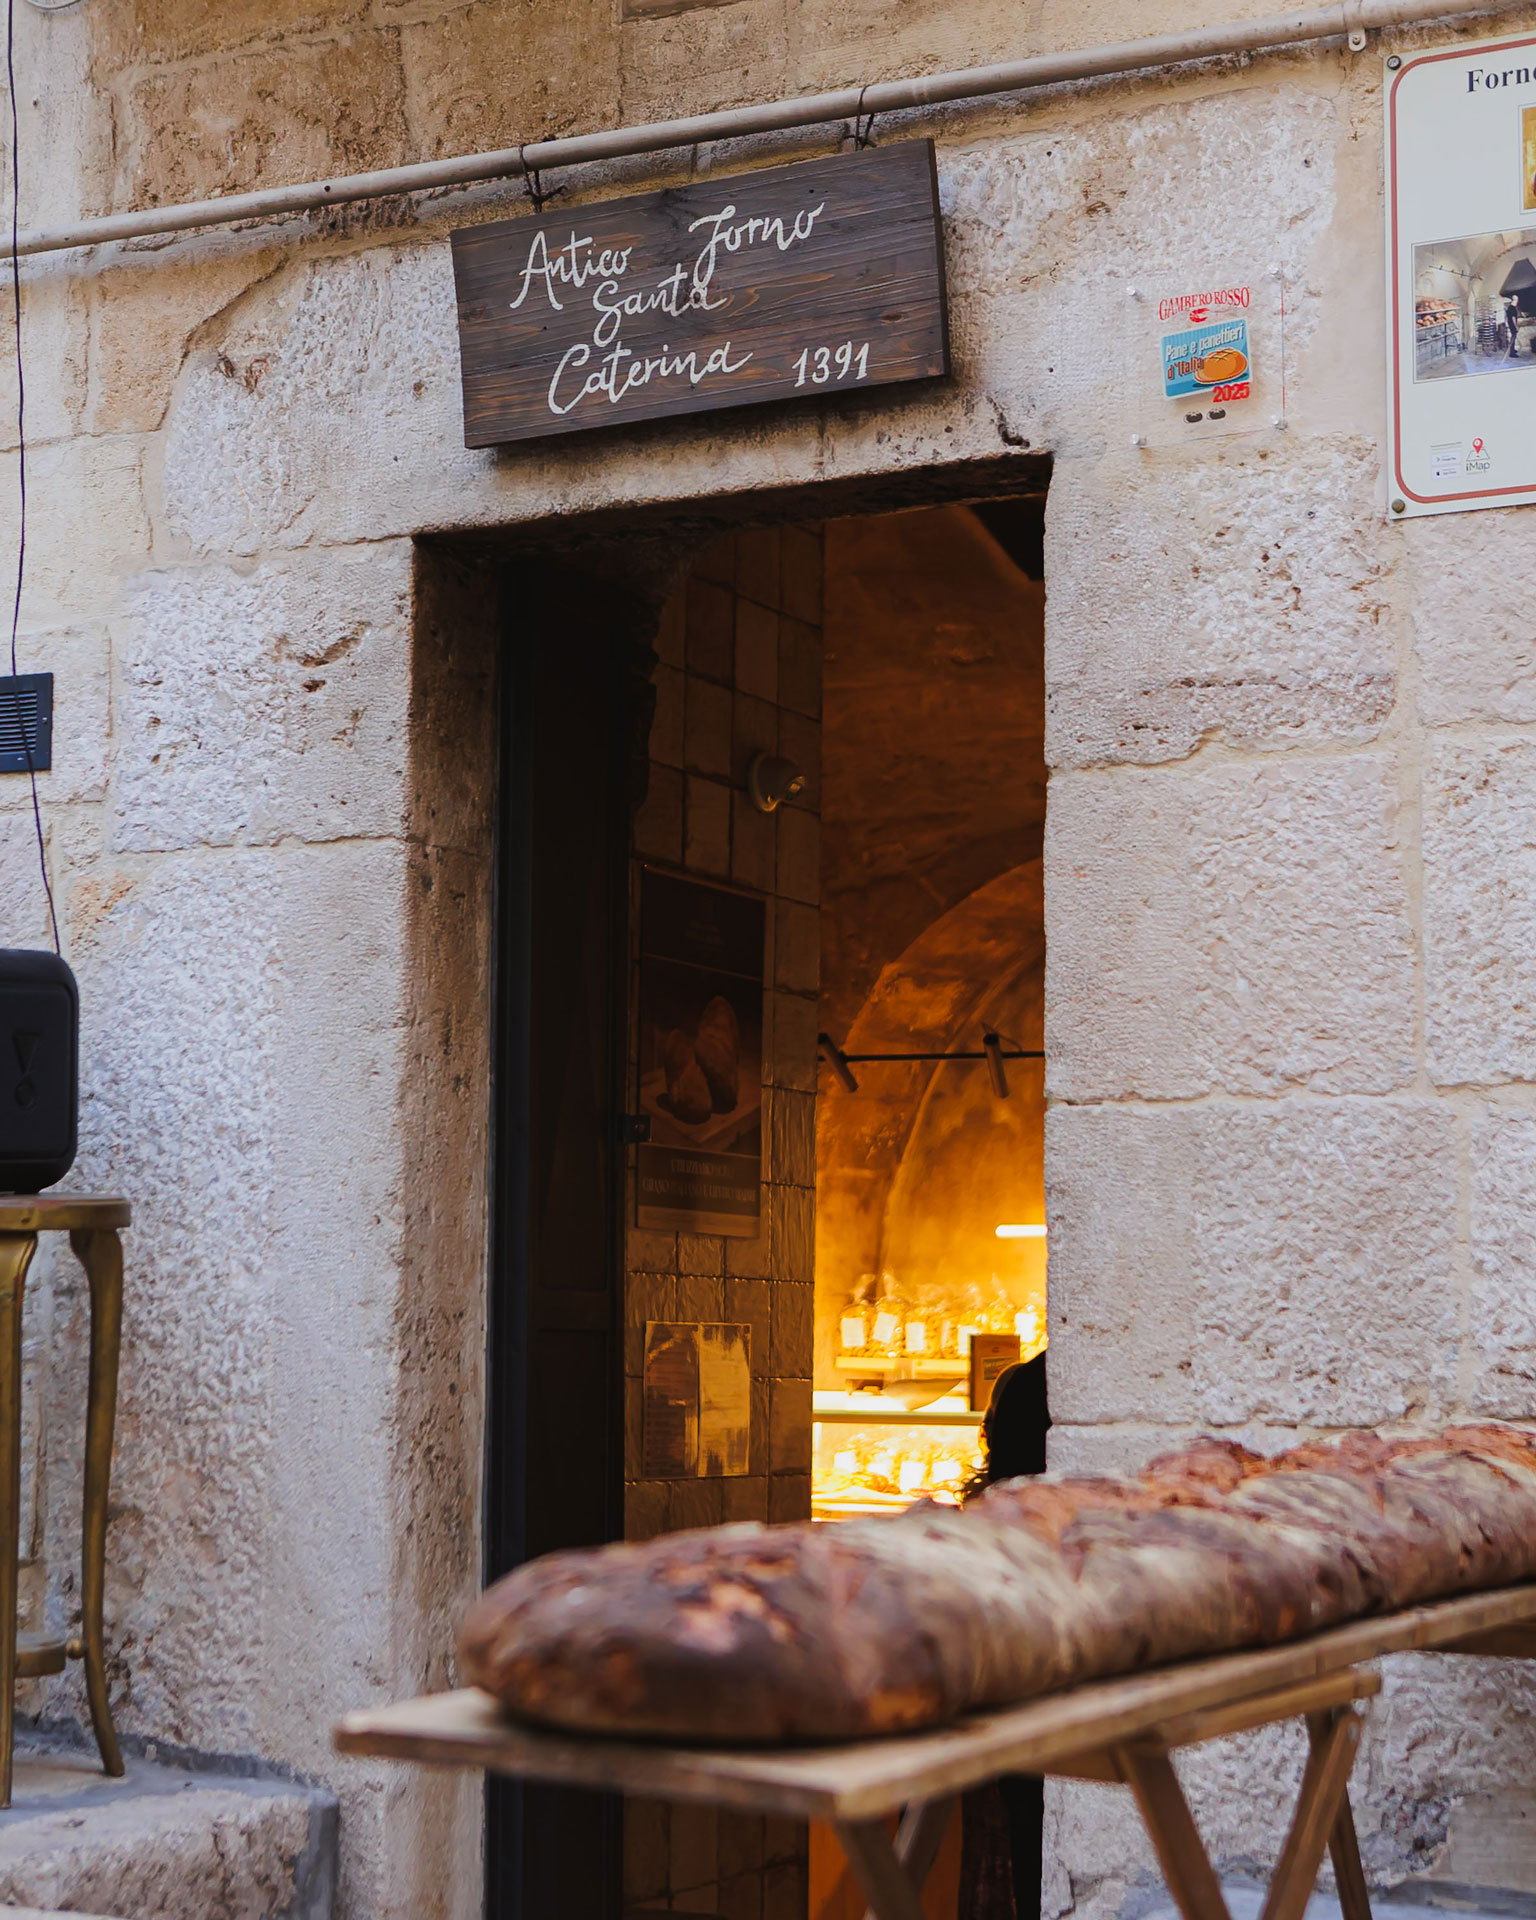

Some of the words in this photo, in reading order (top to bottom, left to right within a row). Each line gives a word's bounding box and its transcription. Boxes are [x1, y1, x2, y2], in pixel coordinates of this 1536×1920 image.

[1466, 66, 1536, 93] Forn
[508, 230, 633, 310] Antico
[688, 202, 826, 284] Forno
[592, 263, 728, 347] Santa
[1159, 293, 1212, 320] GAMBERO
[1214, 286, 1250, 308] ROSSO
[1166, 344, 1188, 361] Pane
[1190, 340, 1197, 353] e
[1199, 324, 1244, 354] panettieri
[547, 341, 754, 415] Caterina
[791, 340, 870, 388] 1391
[1213, 382, 1250, 403] 2025
[1465, 461, 1491, 473] iMap
